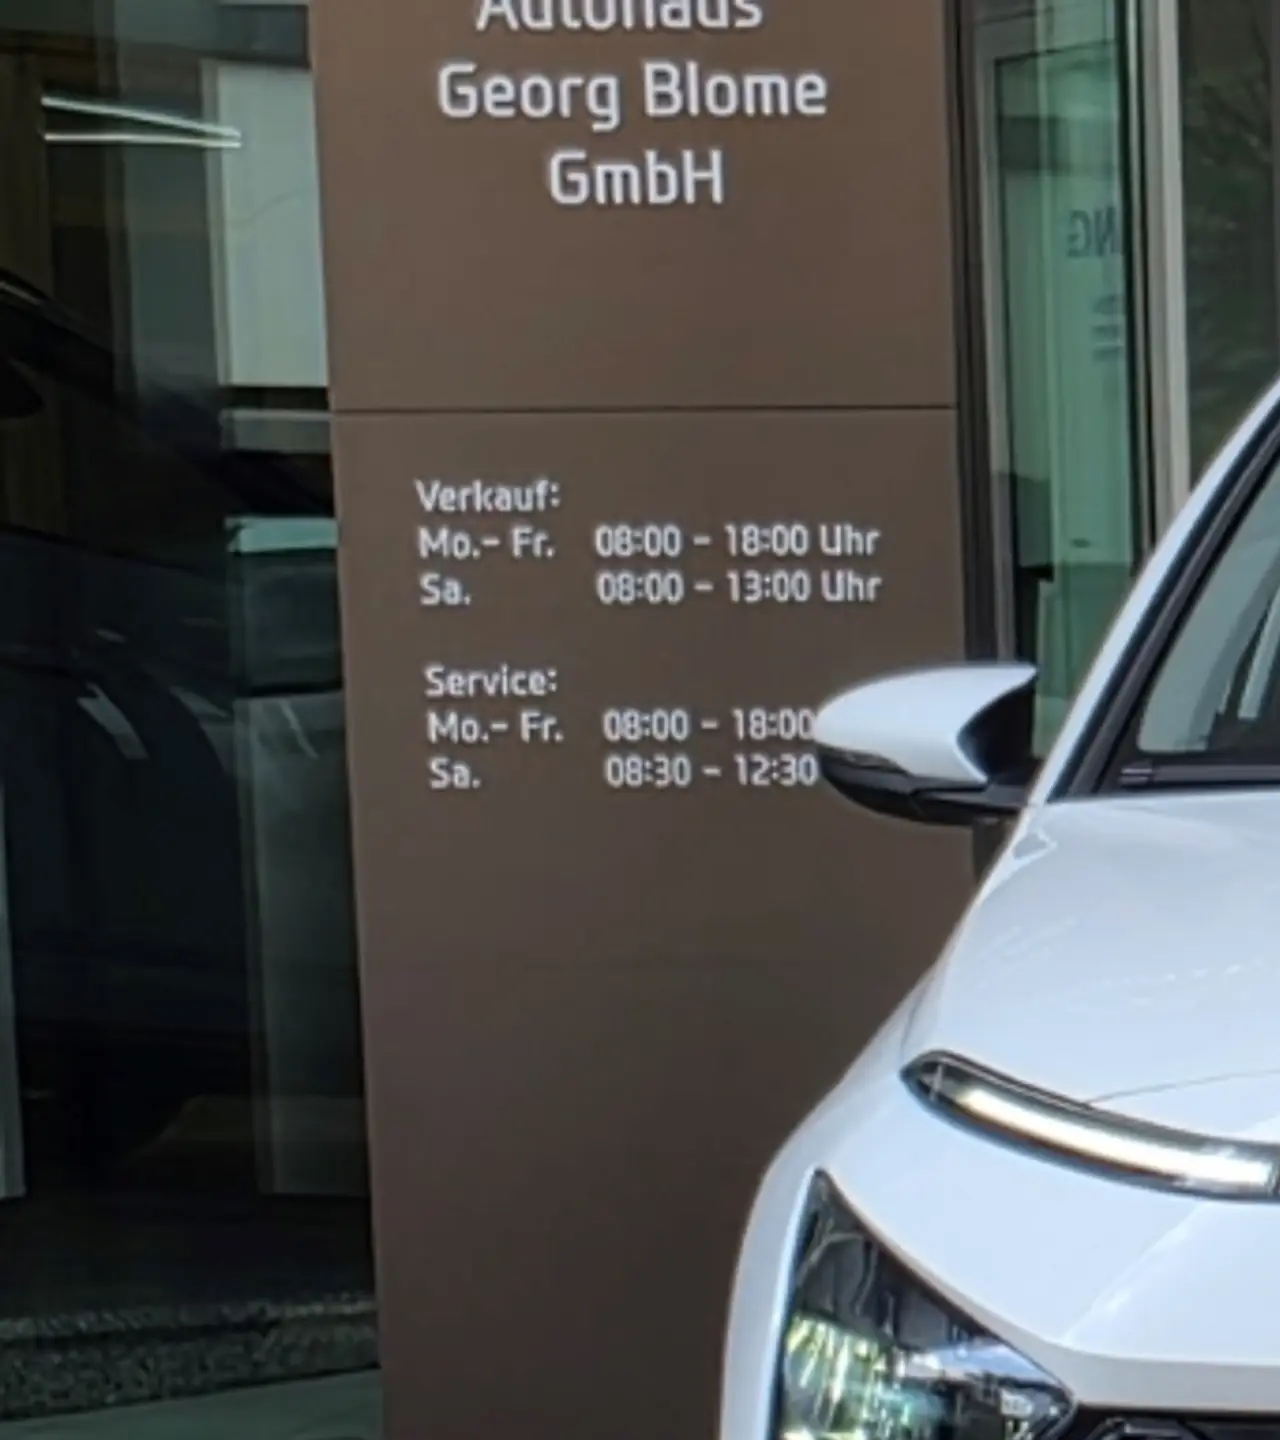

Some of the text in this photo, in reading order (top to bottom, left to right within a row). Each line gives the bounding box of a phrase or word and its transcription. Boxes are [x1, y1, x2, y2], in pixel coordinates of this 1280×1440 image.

[438, 60, 829, 133] Georg Blome
[549, 148, 724, 205] GmbH
[415, 479, 561, 512] Verkauf:
[511, 527, 556, 558] Fr.
[595, 524, 682, 557] 08:00
[725, 524, 808, 557] 18:00
[819, 524, 880, 556] Uhr
[418, 572, 471, 605] Sa.
[596, 571, 684, 604] 08:00
[726, 571, 811, 603] 13:00
[820, 571, 882, 603] Uhr
[424, 665, 558, 698] Service:
[519, 711, 564, 743] Fr.
[603, 708, 690, 741] 08:00
[732, 708, 816, 741] 18:00
[429, 757, 481, 790] Sa.
[605, 754, 692, 788] 08:30
[737, 754, 819, 787] 12:30
